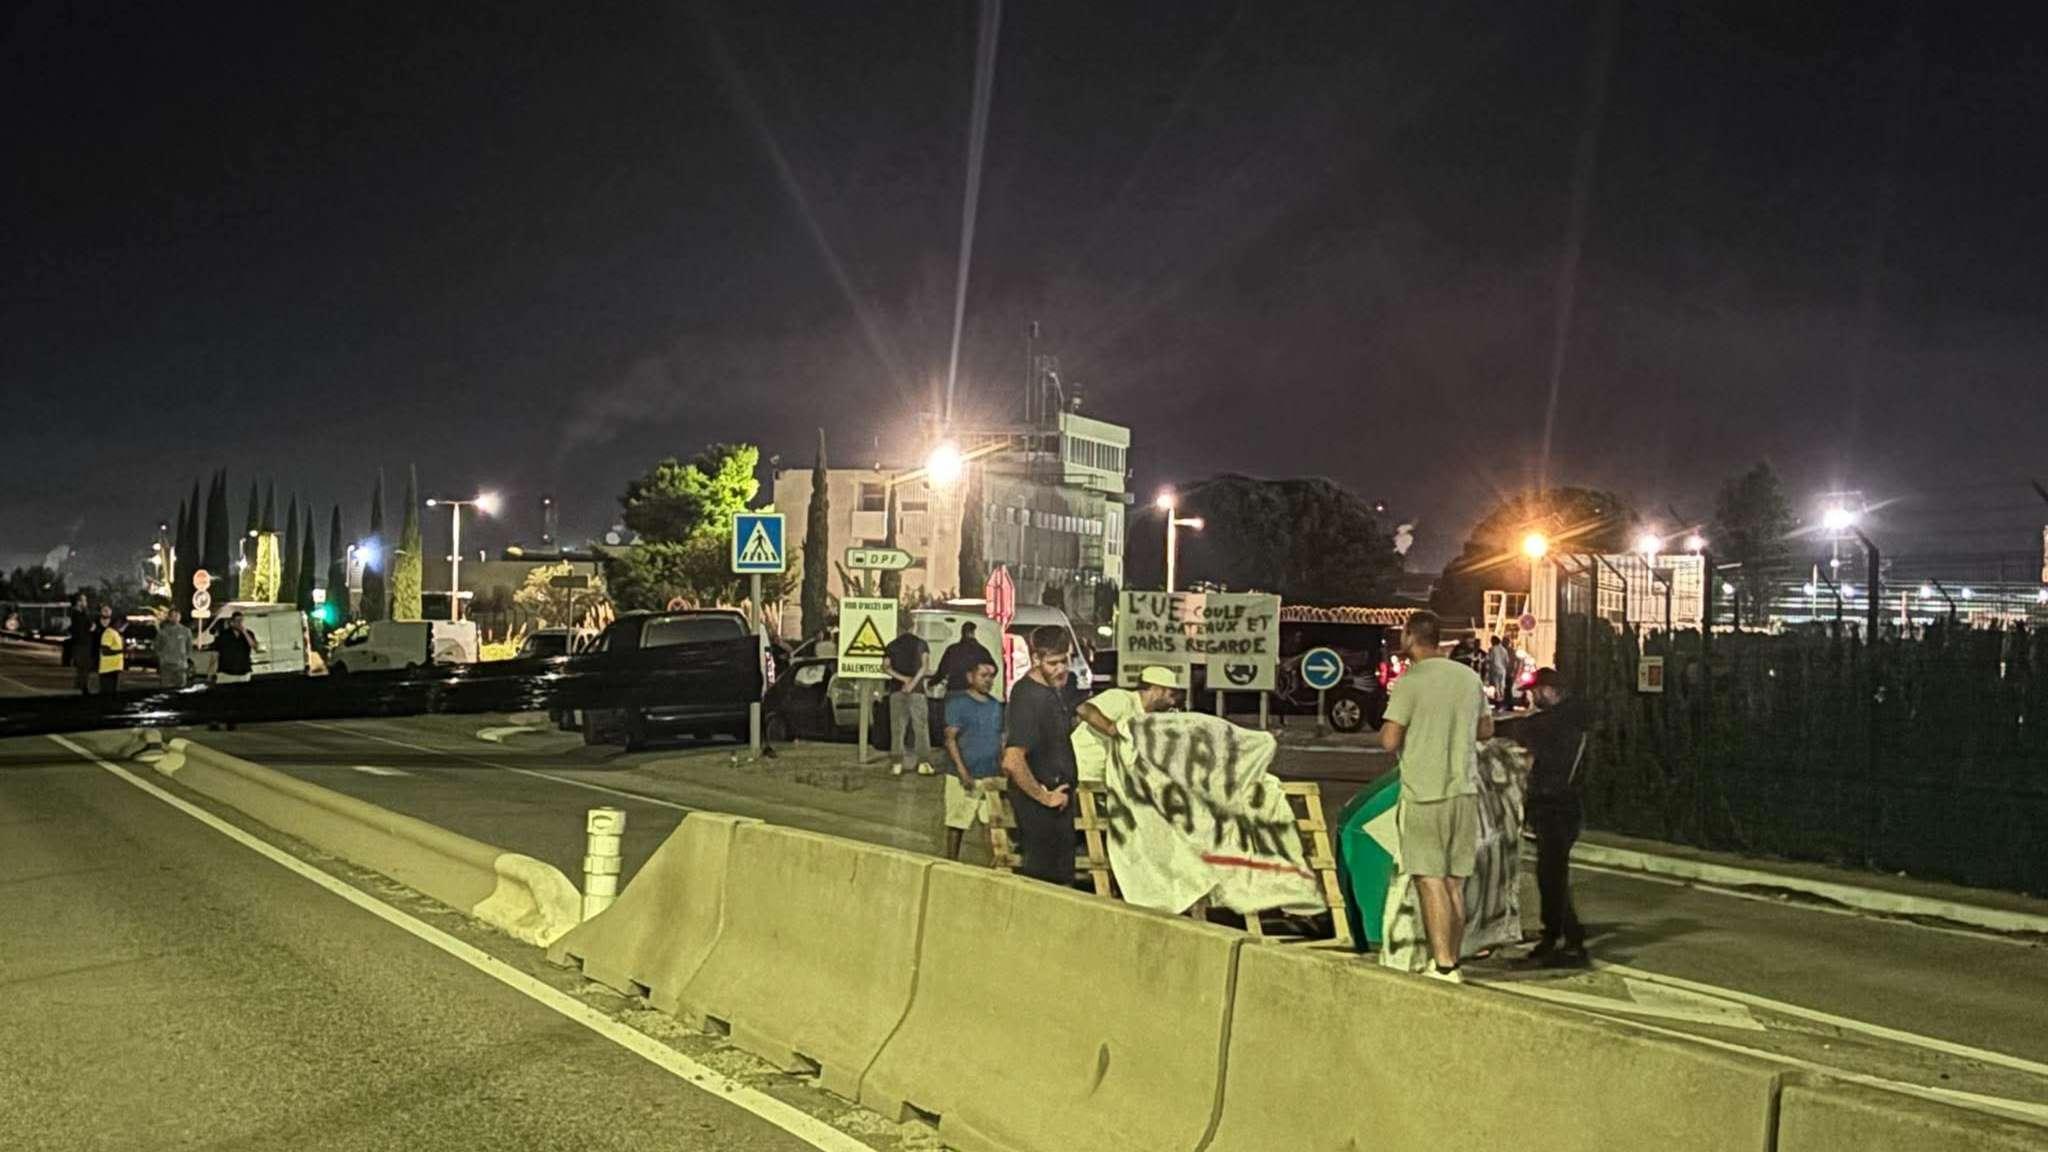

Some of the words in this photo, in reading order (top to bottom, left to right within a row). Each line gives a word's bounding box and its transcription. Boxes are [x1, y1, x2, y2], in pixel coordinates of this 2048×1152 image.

[870, 554, 898, 564] DPF
[1128, 593, 1186, 622] L'UE
[1194, 605, 1246, 620] COULE
[1136, 619, 1159, 632] NOS
[1165, 621, 1236, 635] BATEAUX
[1247, 614, 1273, 632] ET
[1185, 637, 1267, 654] REGARDE
